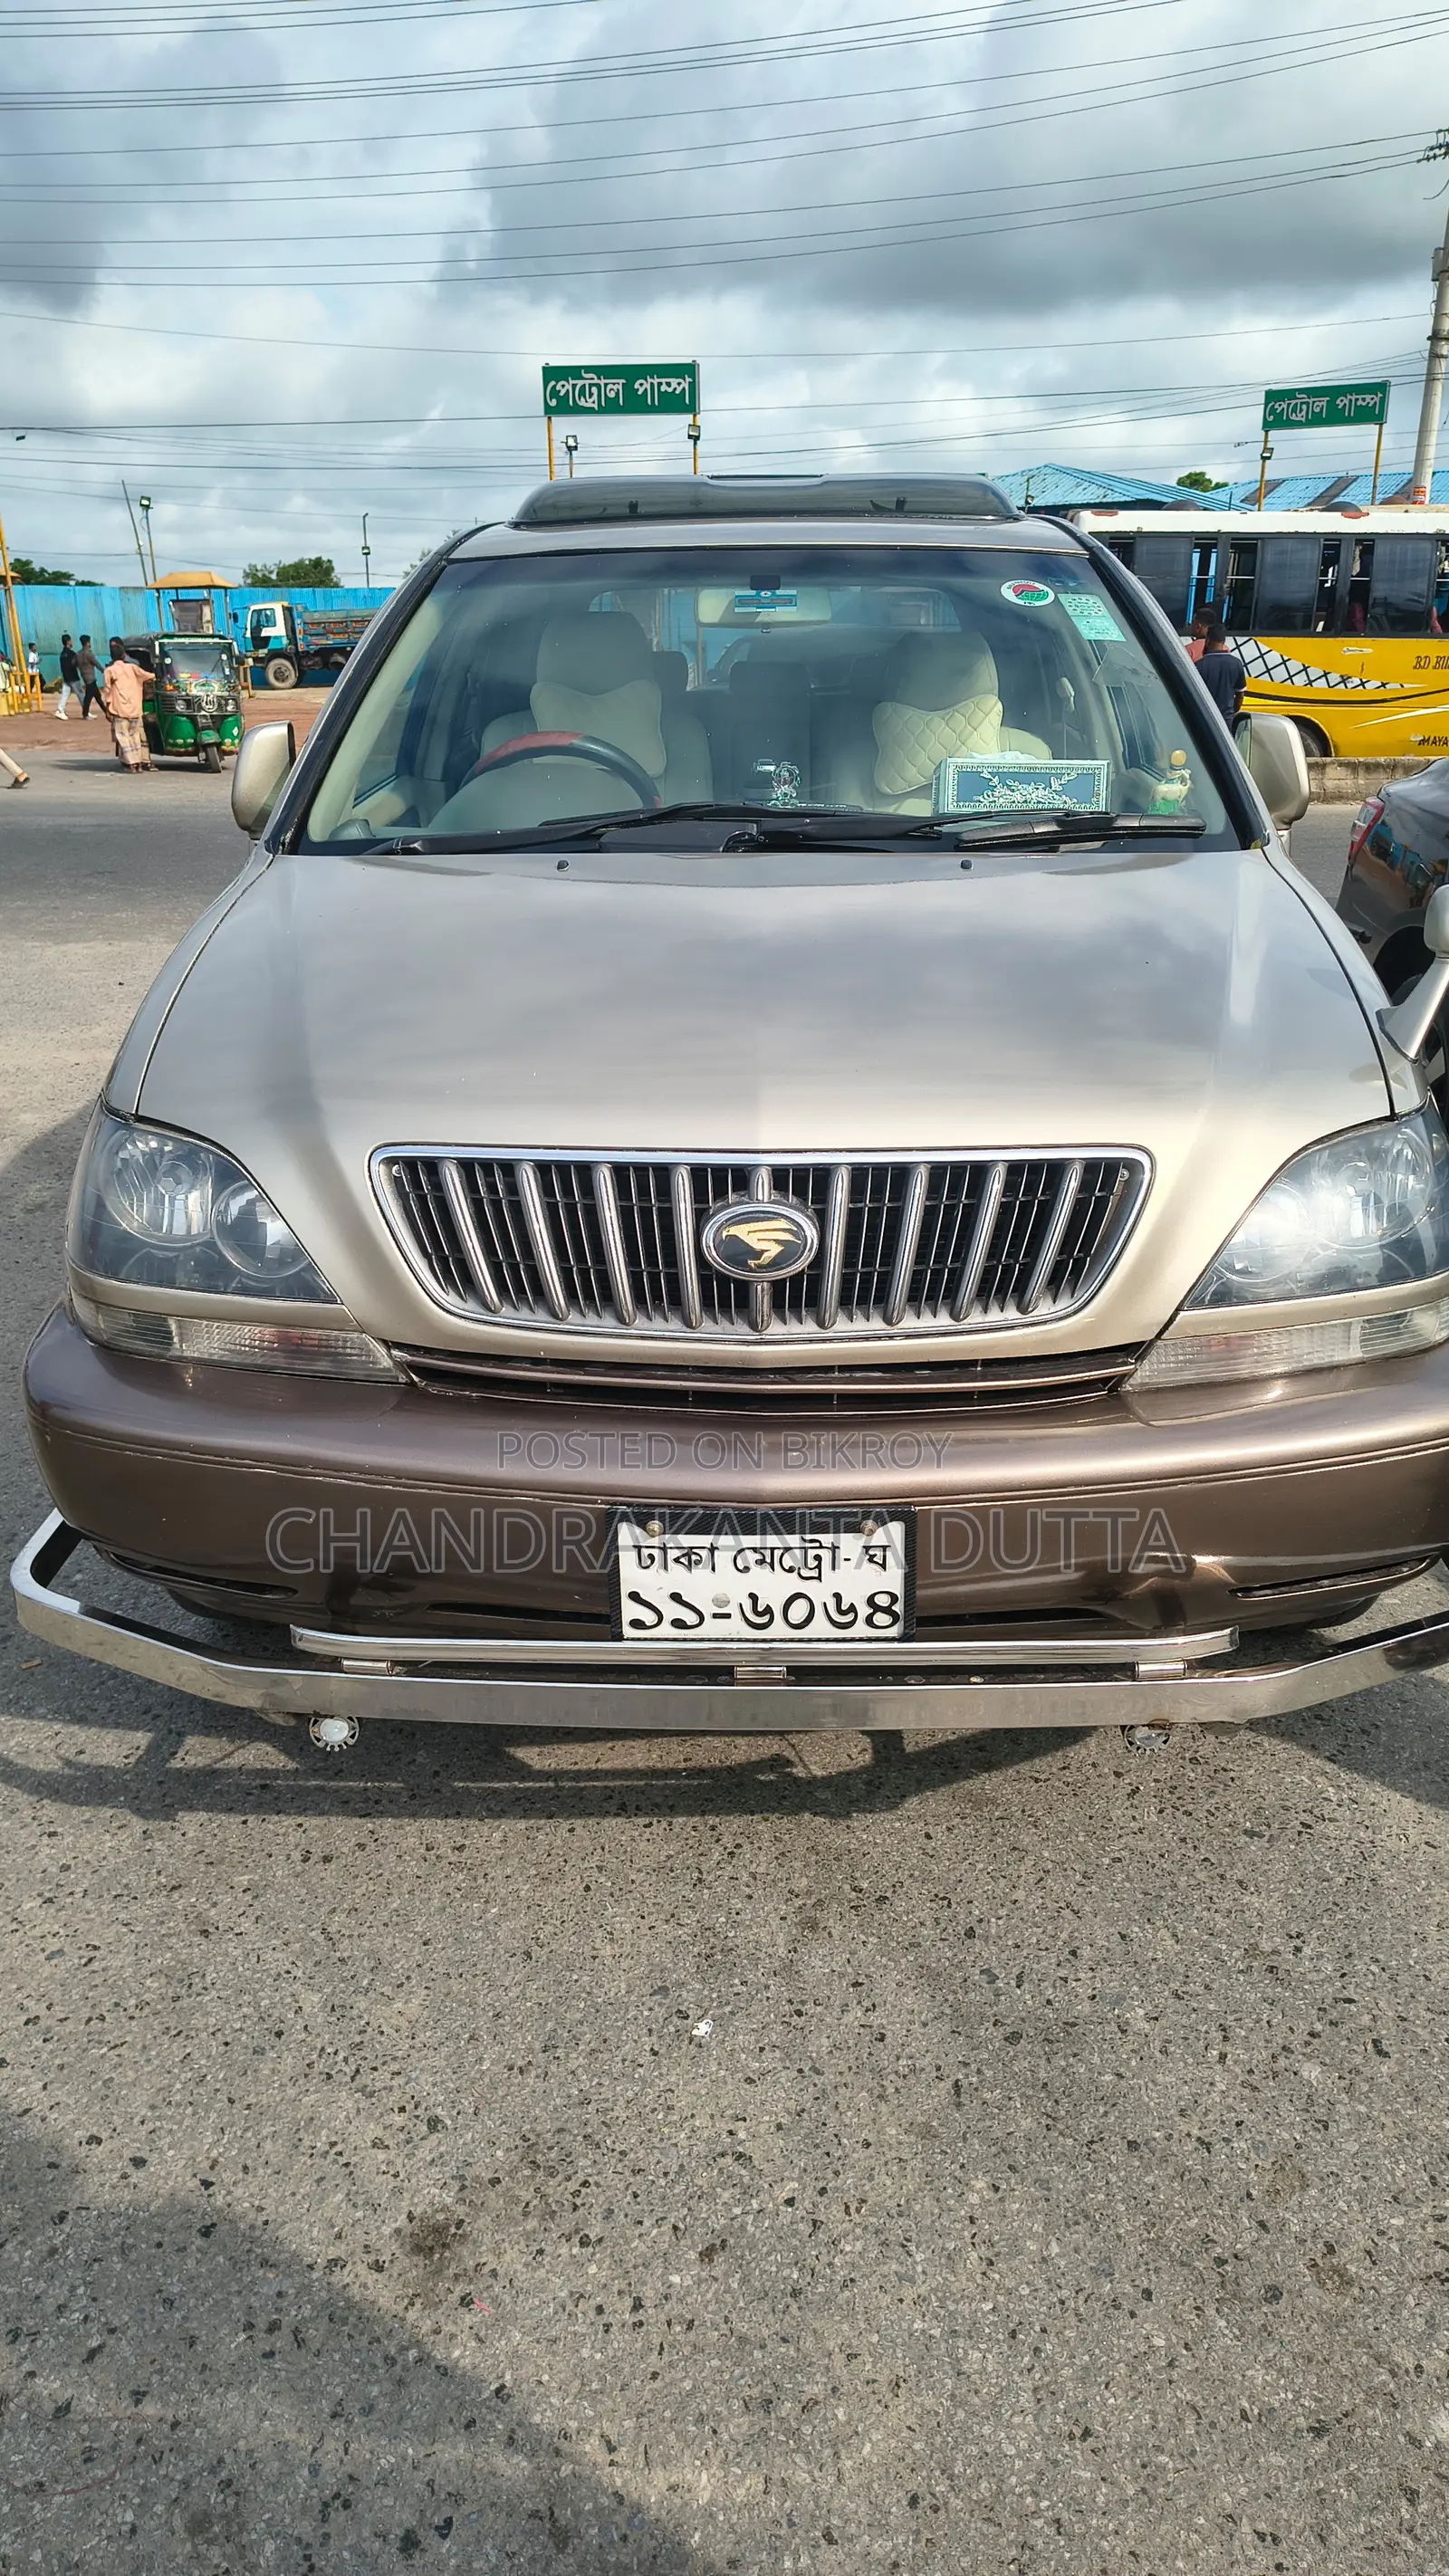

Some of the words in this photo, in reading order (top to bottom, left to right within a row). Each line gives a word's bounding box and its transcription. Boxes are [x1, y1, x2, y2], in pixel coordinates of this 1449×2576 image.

[546, 369, 627, 411] পেট্রোল
[634, 374, 693, 407] পাম্প
[1266, 391, 1330, 423] পেট্রোল
[1336, 391, 1384, 417] পাম্প
[631, 1540, 720, 1574] ঢাকা
[627, 1590, 902, 1631] ১১-৬০৬৪
